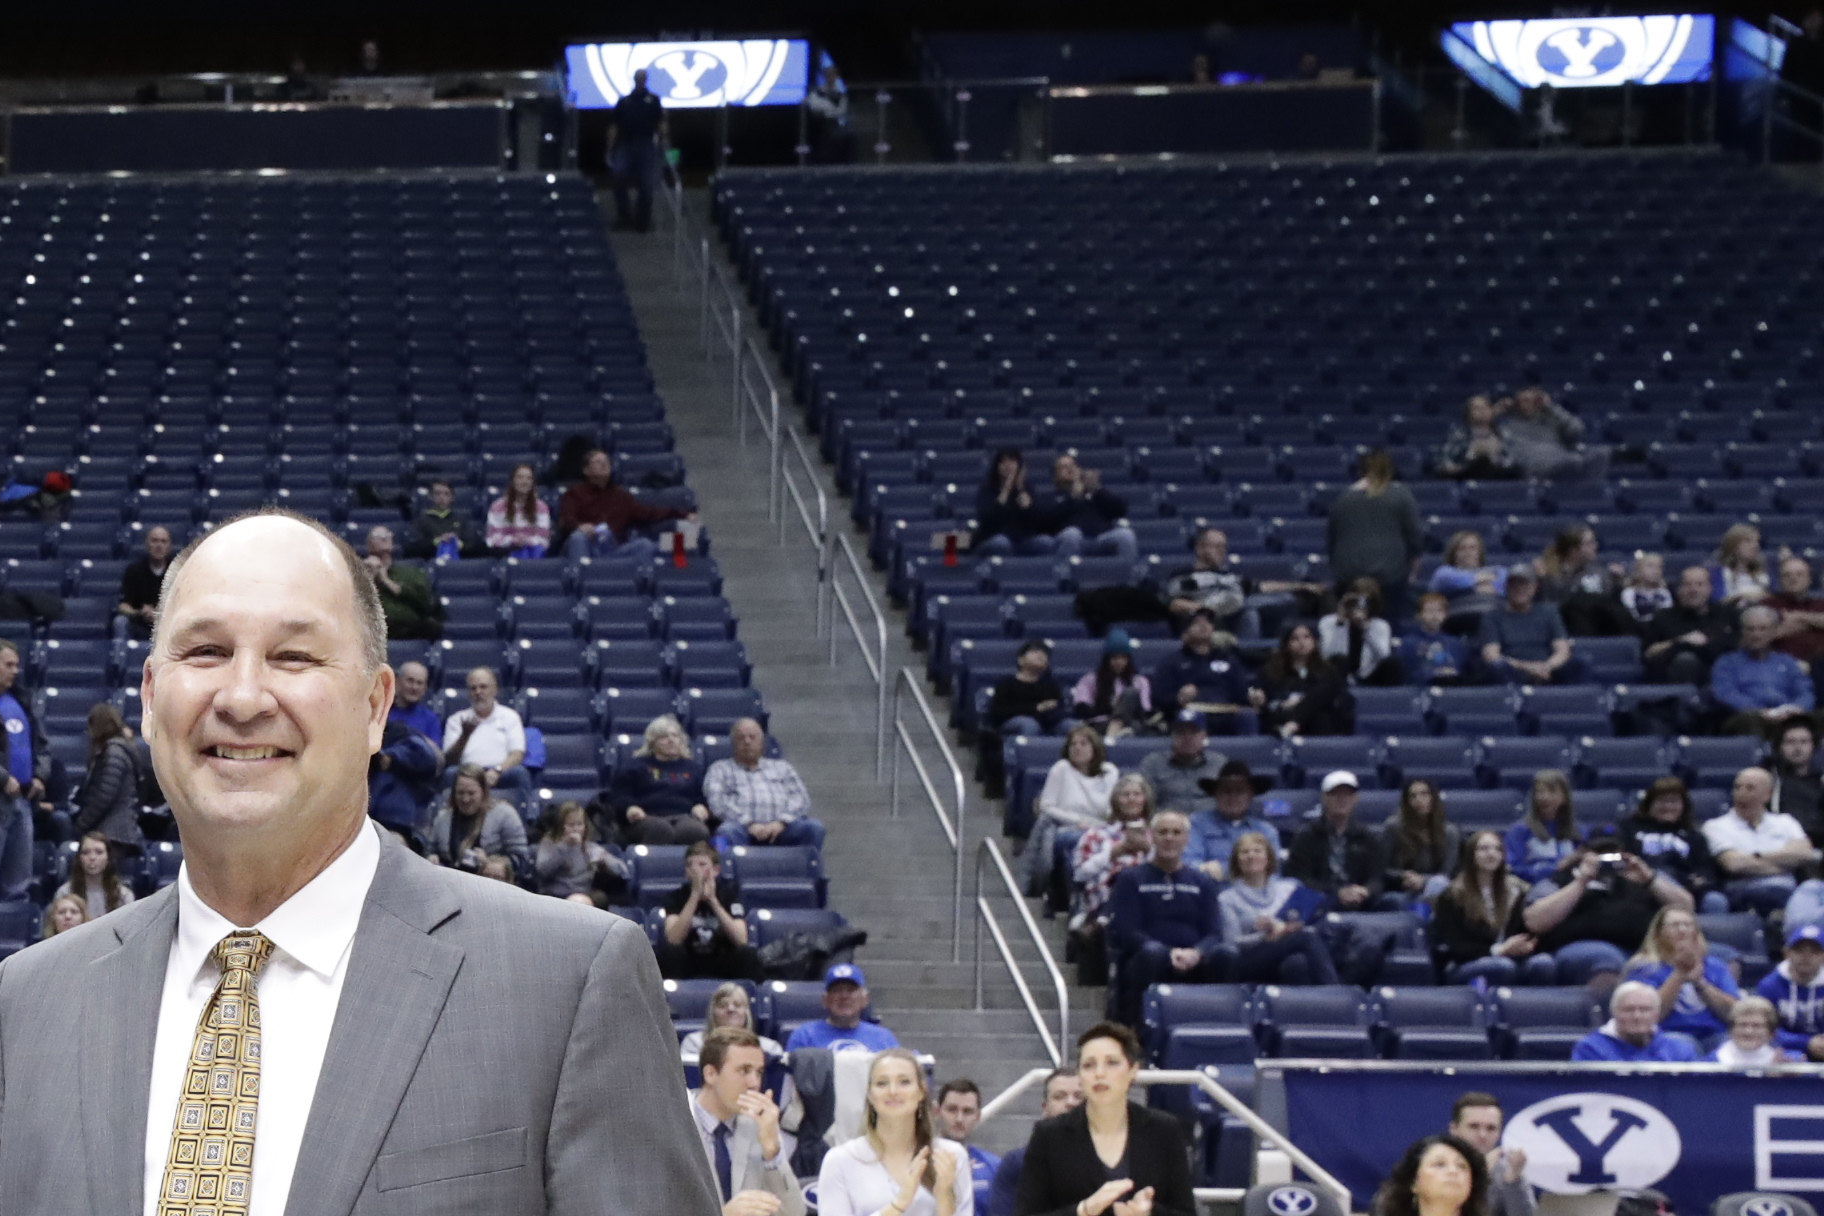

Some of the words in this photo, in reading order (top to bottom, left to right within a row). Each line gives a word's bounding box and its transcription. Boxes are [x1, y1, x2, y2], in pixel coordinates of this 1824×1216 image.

[655, 51, 718, 98] Y
[1546, 27, 1617, 77] Y
[1532, 1105, 1649, 1184] Y
